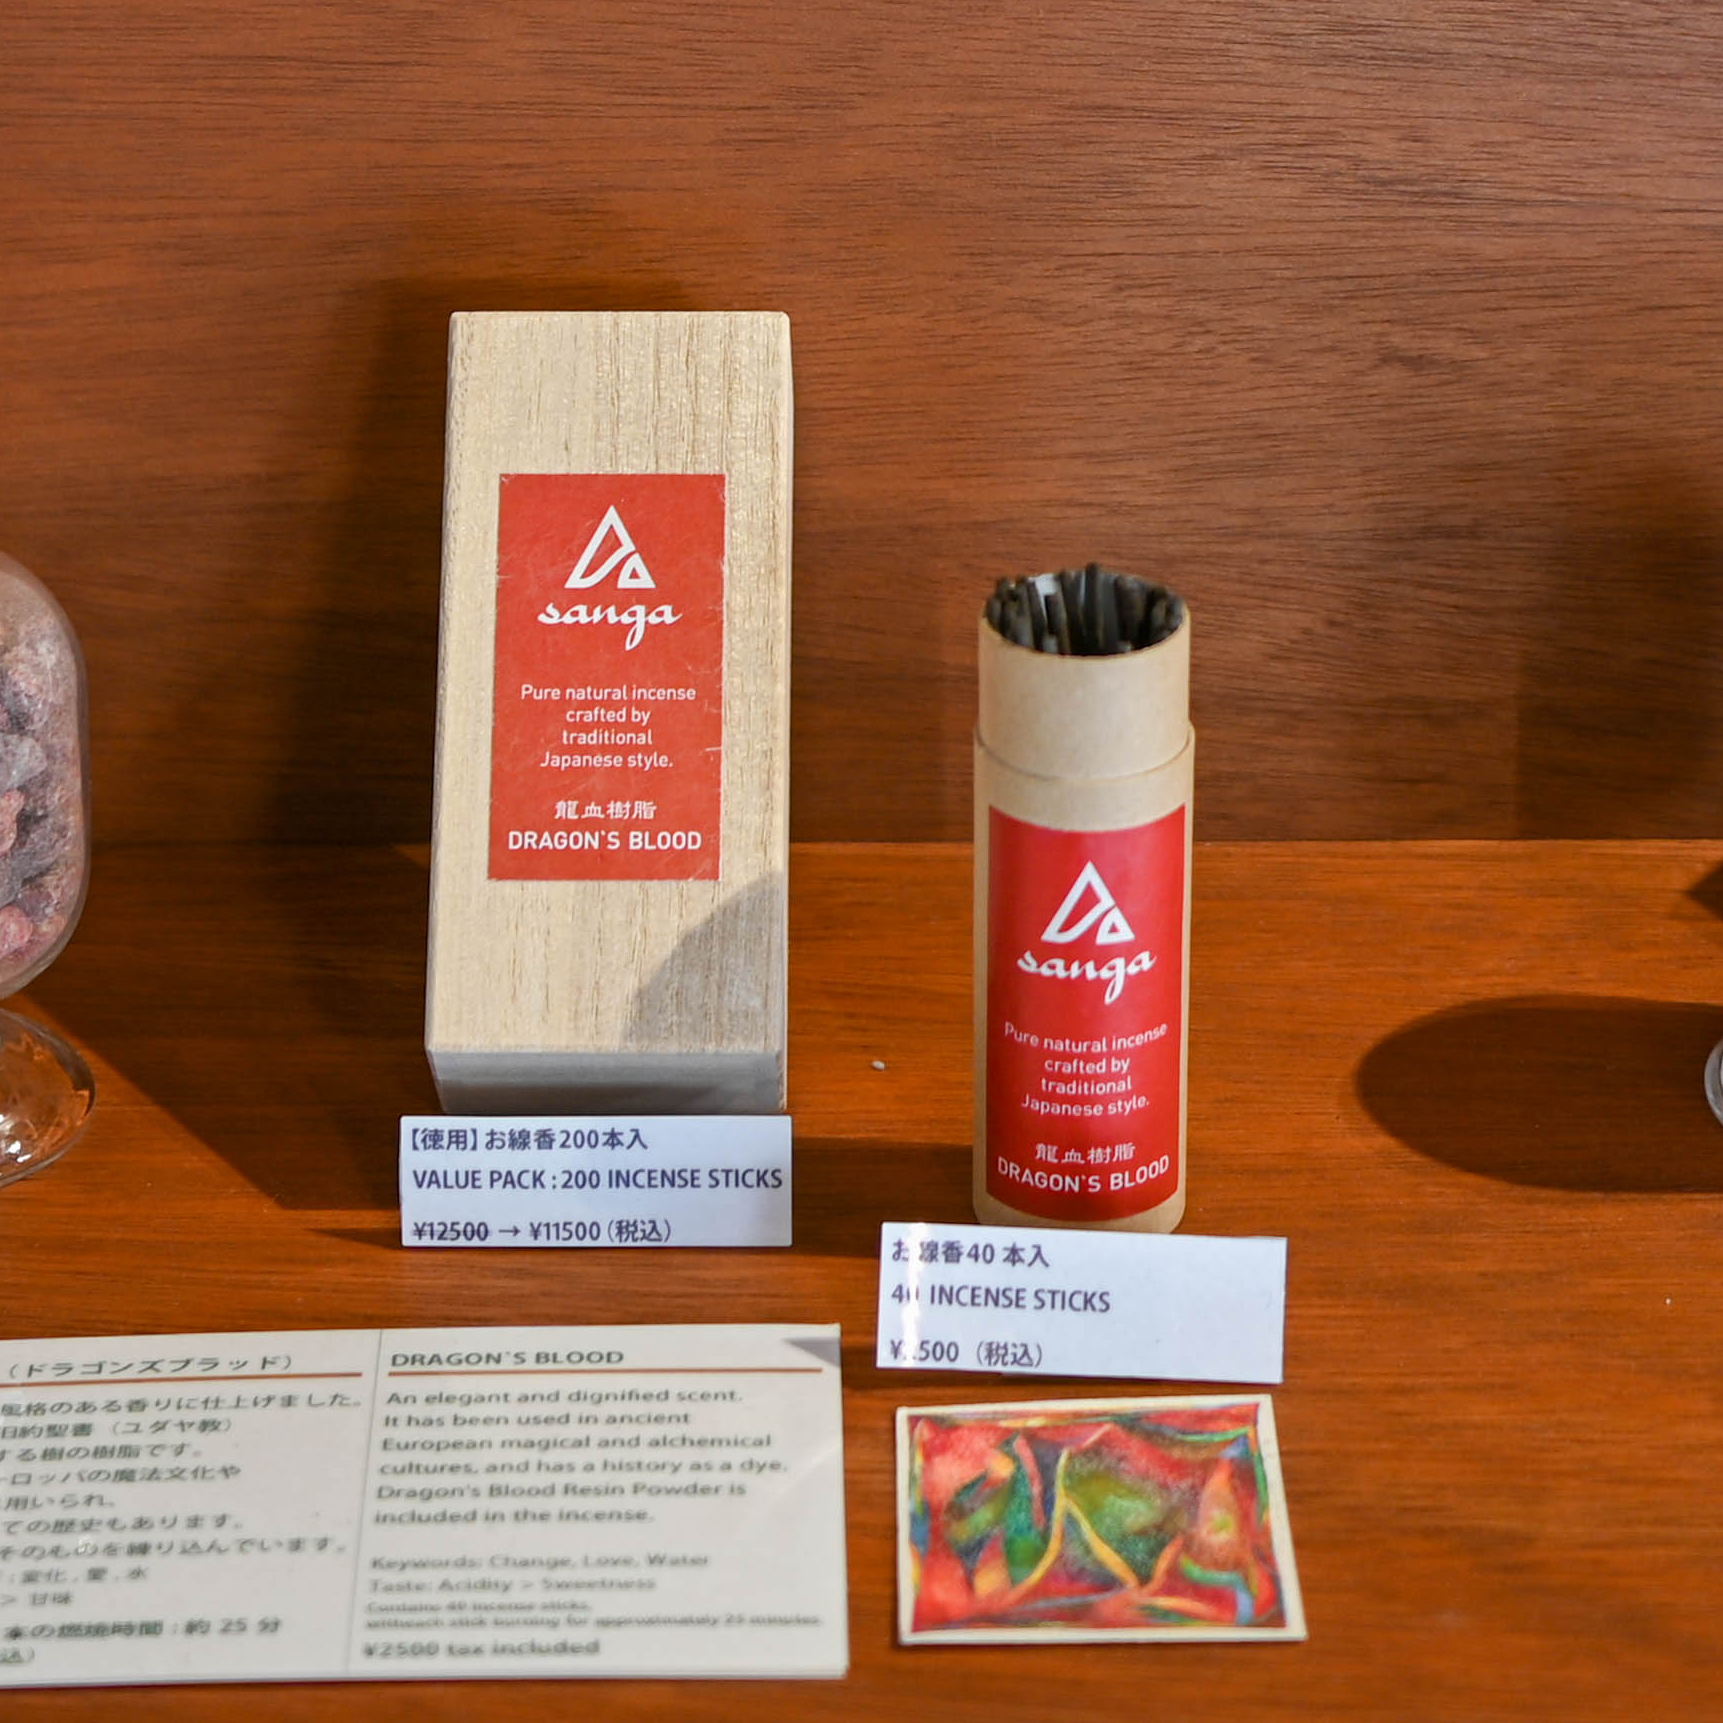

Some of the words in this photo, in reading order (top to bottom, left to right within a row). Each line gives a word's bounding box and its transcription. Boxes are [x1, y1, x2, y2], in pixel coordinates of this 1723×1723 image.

[538, 603, 682, 651] sanga
[521, 684, 560, 700] Pure
[566, 685, 627, 700] natural
[633, 684, 696, 700] incense
[566, 707, 626, 724] crafted
[631, 707, 650, 726] by
[563, 729, 652, 744] traditional
[540, 751, 623, 771] Japanese
[628, 752, 673, 771] style.
[629, 831, 701, 850] BLOOD
[1017, 951, 1156, 1005] sanga
[1005, 1022, 1039, 1047] Pure
[1044, 1037, 1107, 1052] natural
[1112, 1024, 1167, 1050] incense
[1045, 1058, 1106, 1073] crafted
[1109, 1058, 1130, 1075] by
[1042, 1076, 1132, 1095] traditional
[1021, 1094, 1103, 1116] Japanese
[1108, 1095, 1149, 1116] style.
[413, 1170, 482, 1189] VALUE
[609, 1169, 701, 1188] INCENSE
[708, 1169, 782, 1188] STICKS
[1110, 1155, 1169, 1190] BLOOD
[930, 1284, 1026, 1309] INCENSE
[1034, 1289, 1110, 1313] STICKS
[535, 1351, 624, 1364] BLOOD
[890, 1340, 960, 1362] ¥500
[387, 1393, 417, 1404] An
[424, 1392, 510, 1406] elegant
[517, 1390, 560, 1403] and
[568, 1390, 669, 1404] dignified
[677, 1390, 742, 1402] scent.
[385, 1416, 401, 1427] It
[407, 1415, 444, 1427] has
[453, 1414, 509, 1426] been
[517, 1413, 570, 1426] used
[578, 1415, 599, 1424] in
[605, 1413, 689, 1425] ancient
